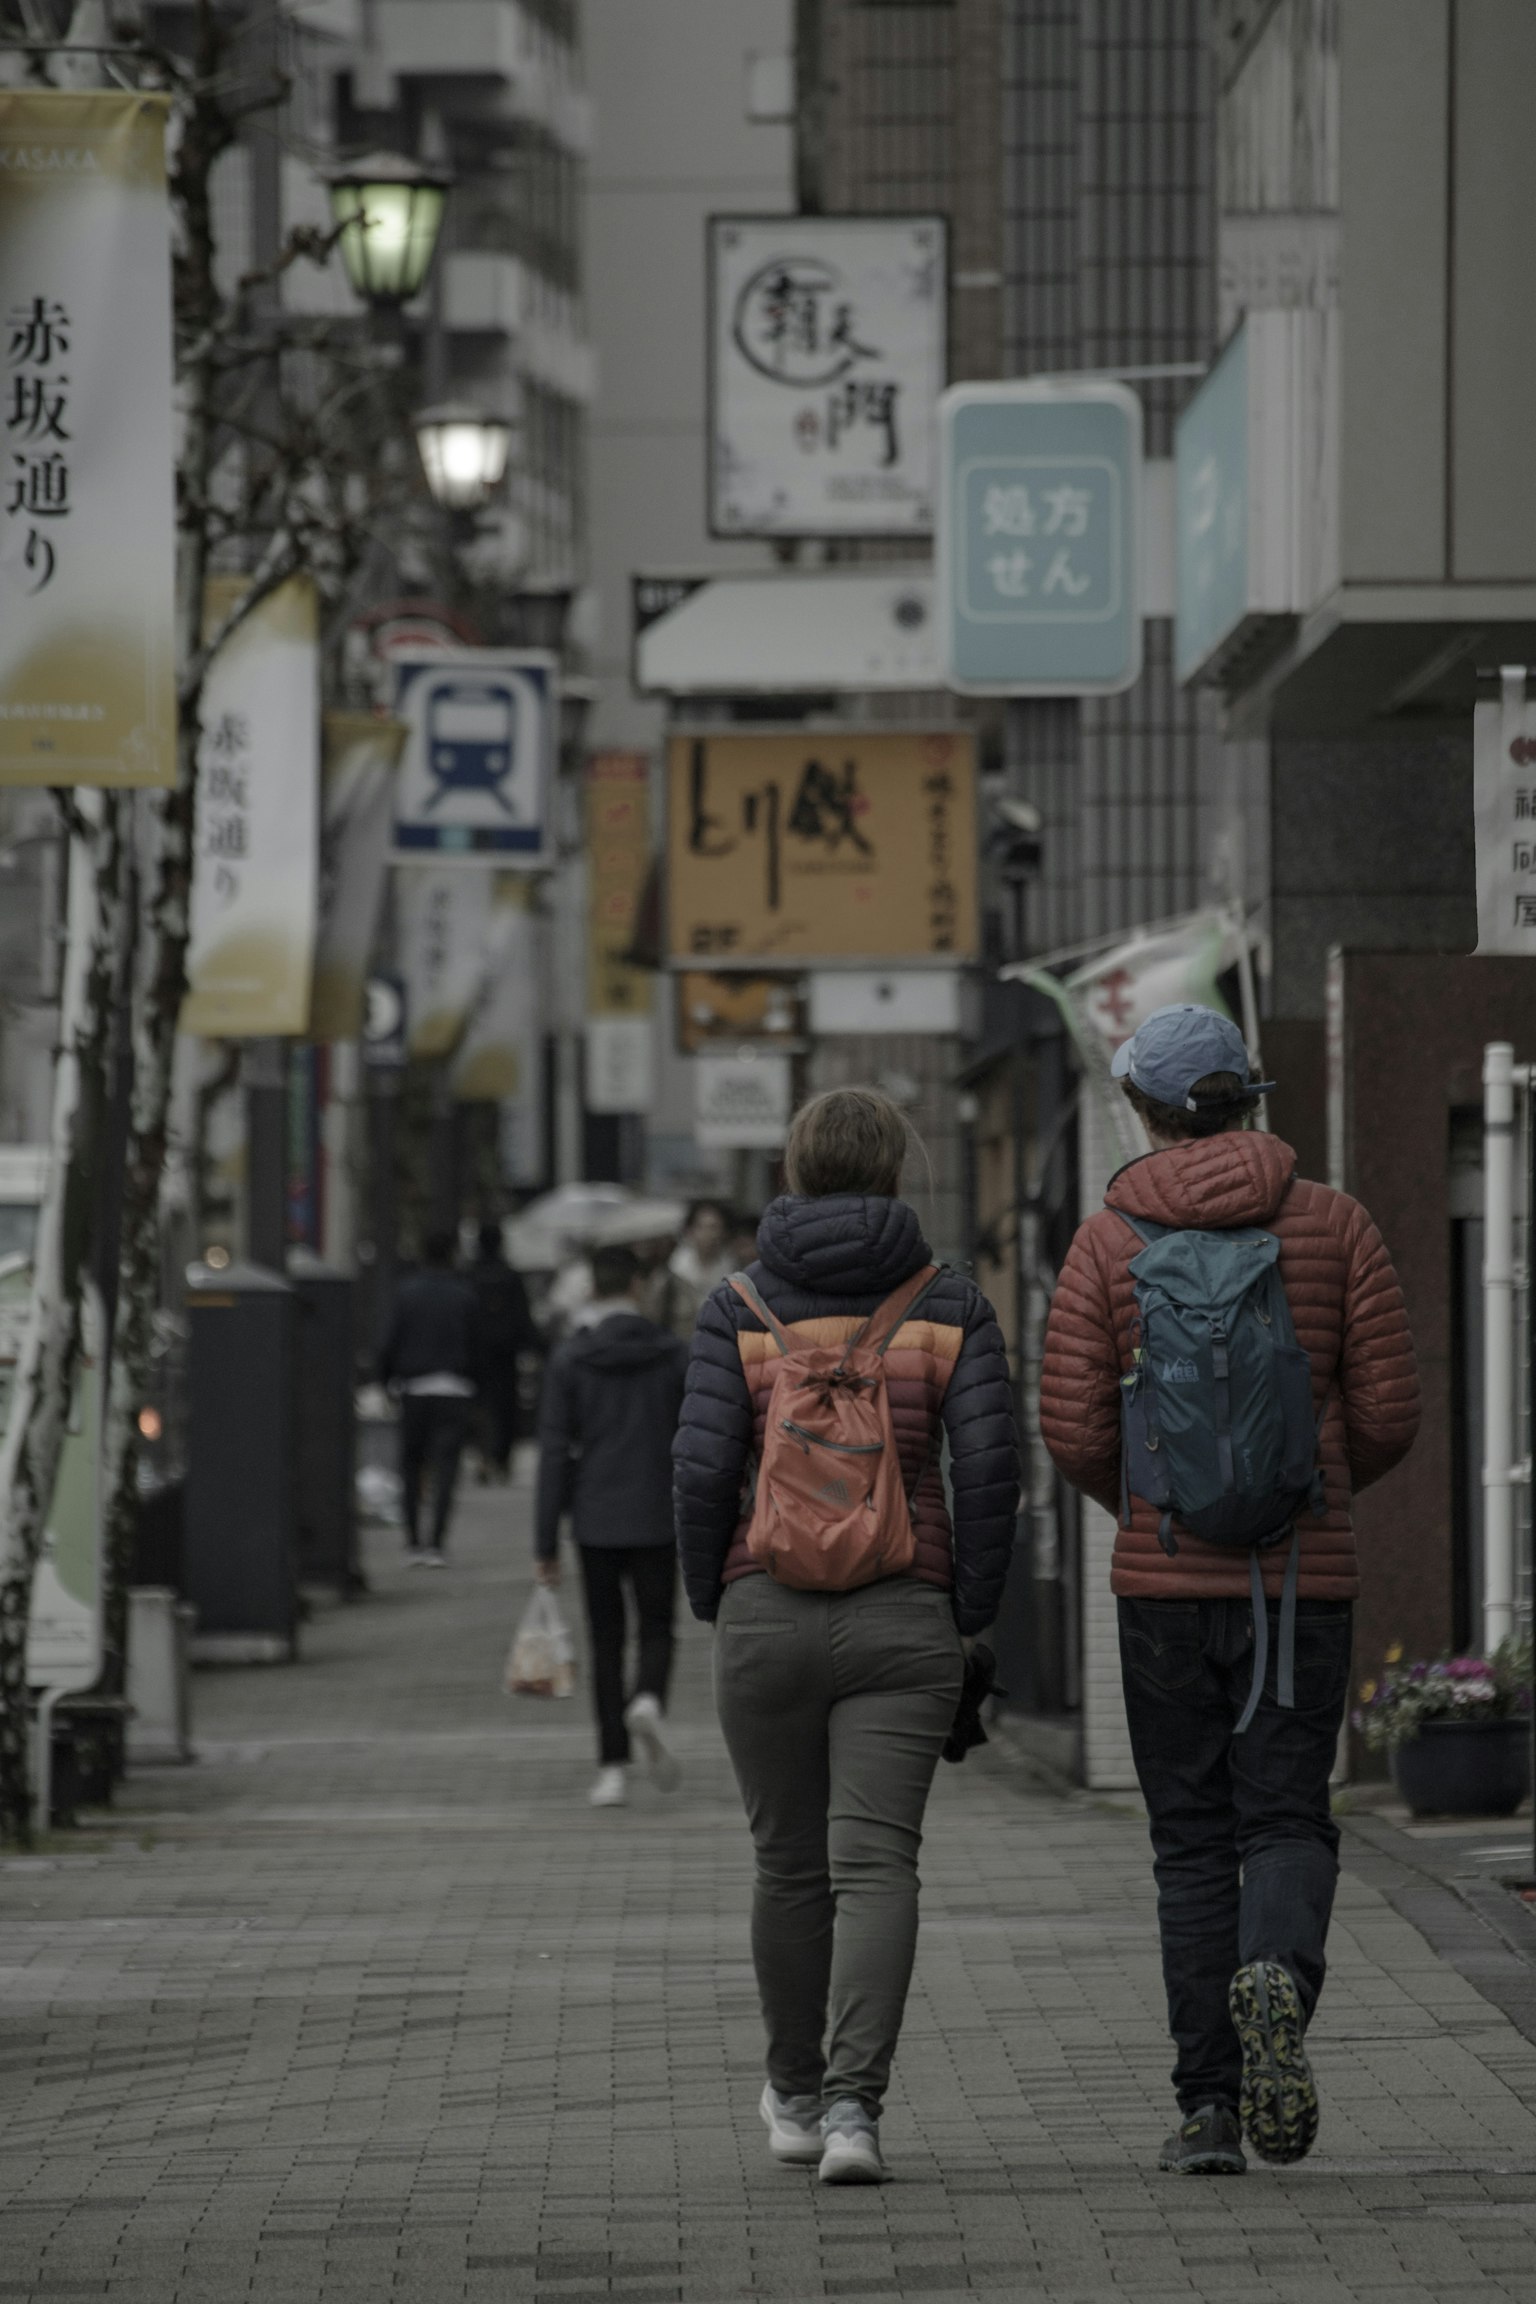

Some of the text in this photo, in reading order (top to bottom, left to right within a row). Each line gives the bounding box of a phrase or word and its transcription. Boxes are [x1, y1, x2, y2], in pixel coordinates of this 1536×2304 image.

[5, 297, 70, 597] 赤坂通り
[983, 484, 1090, 538] 処方
[986, 547, 1092, 596] せん
